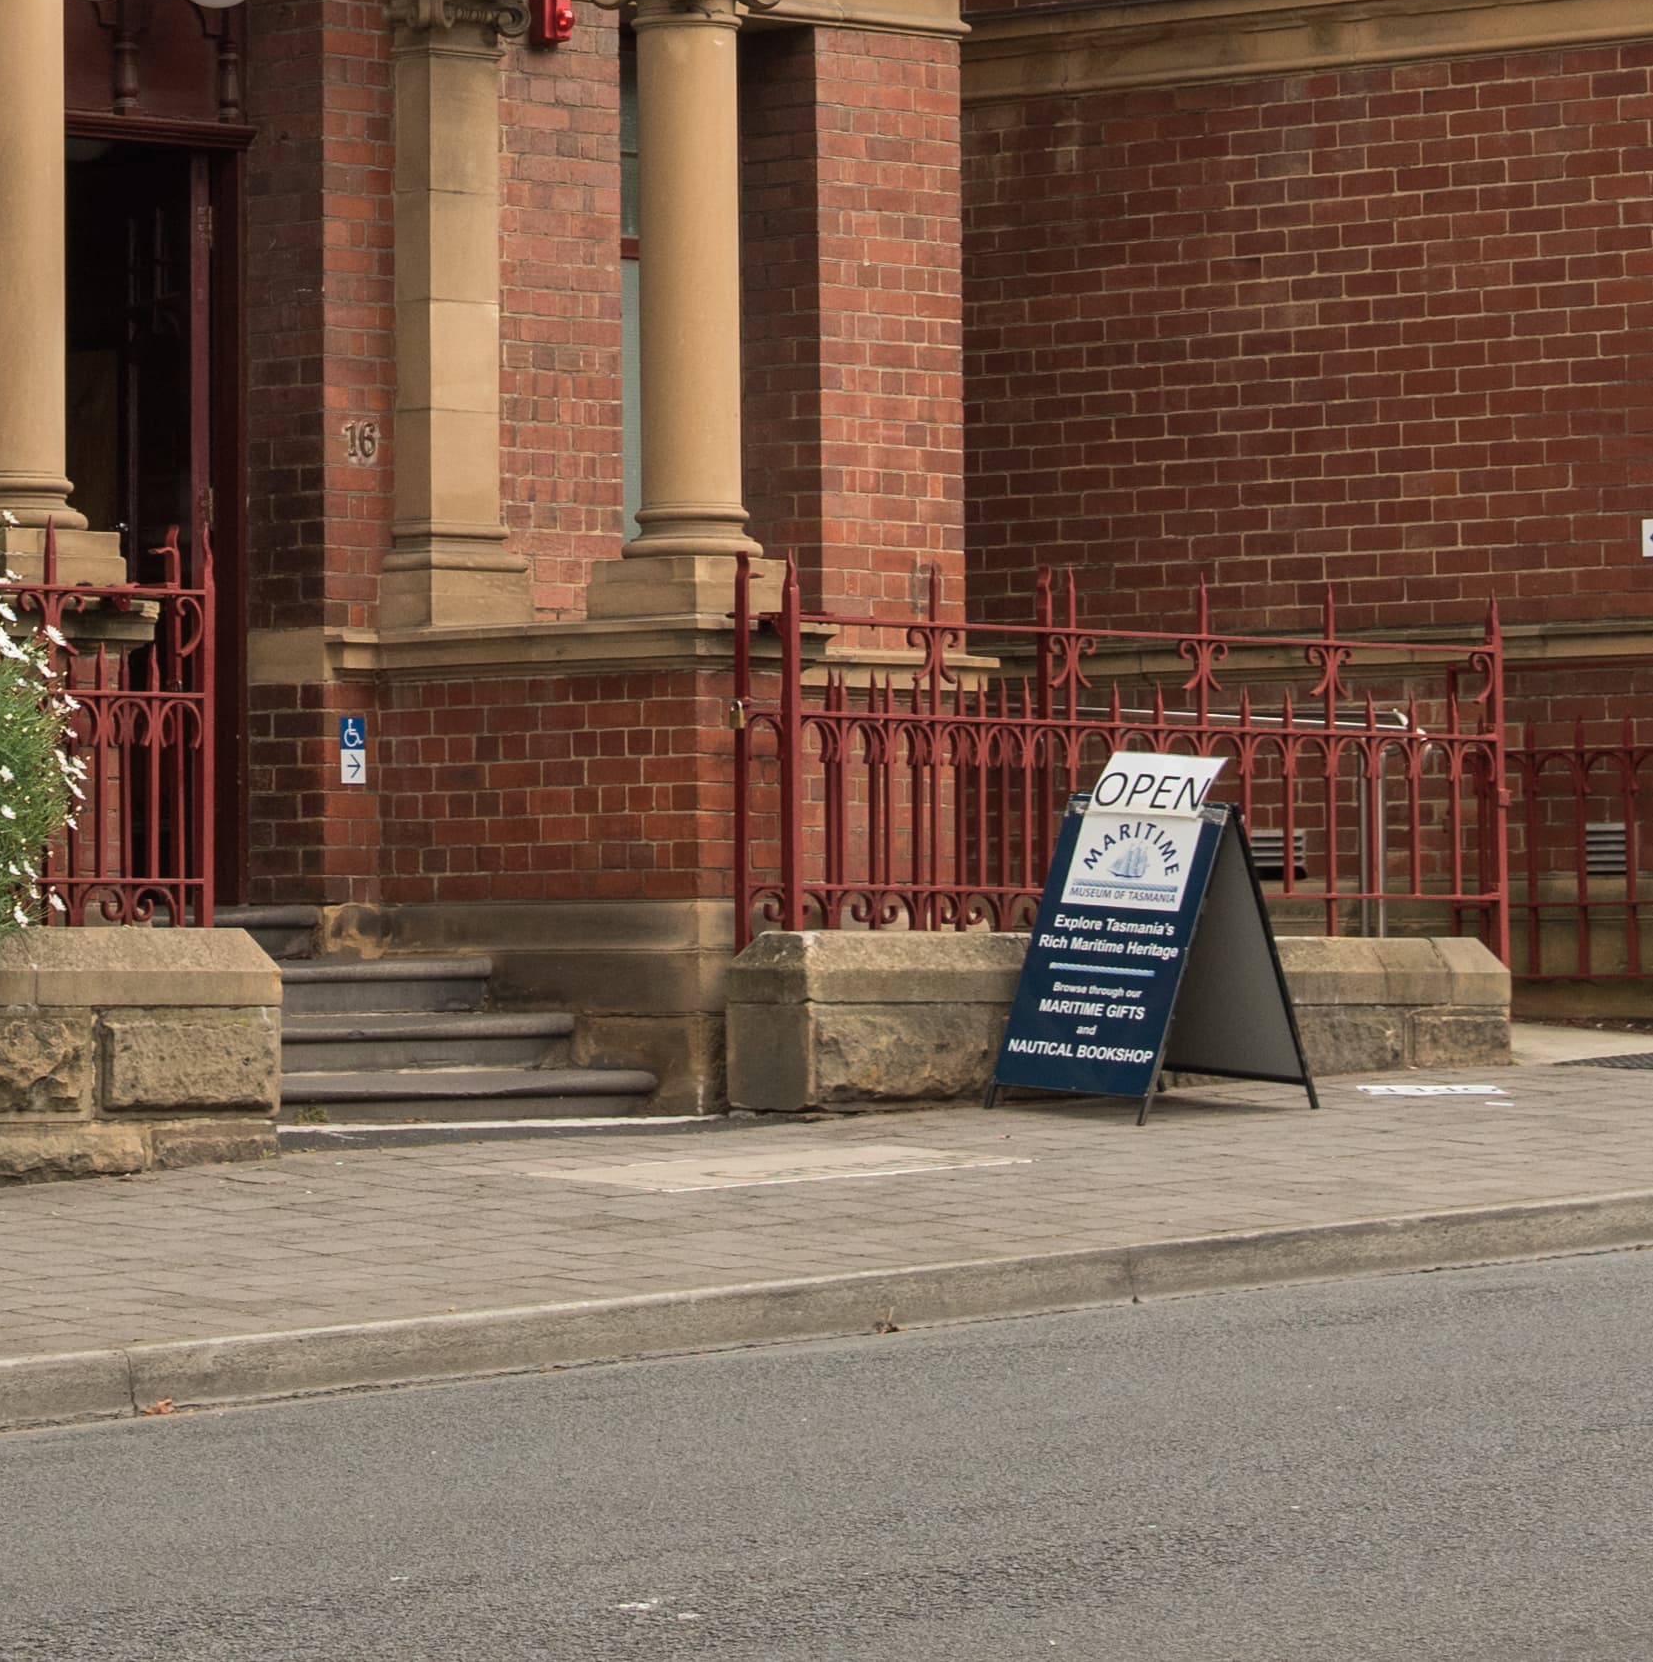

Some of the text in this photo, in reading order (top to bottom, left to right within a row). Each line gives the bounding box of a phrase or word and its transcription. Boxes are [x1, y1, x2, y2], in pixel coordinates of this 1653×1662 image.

[344, 422, 376, 458] 16
[1094, 771, 1212, 812] OPEN
[1083, 821, 1180, 876] MARITIME
[1068, 886, 1176, 904] MUSEUM OF TASMANIA
[1054, 913, 1176, 936] Explore Tasmania's
[1038, 933, 1180, 961] Rich Maritime Heritage
[1052, 981, 1143, 999] Browse through our
[1038, 998, 1146, 1021] MARITIME GIFTS
[1075, 1024, 1097, 1036] and
[1007, 1038, 1154, 1064] NAUTICAL BOOKSHOP
